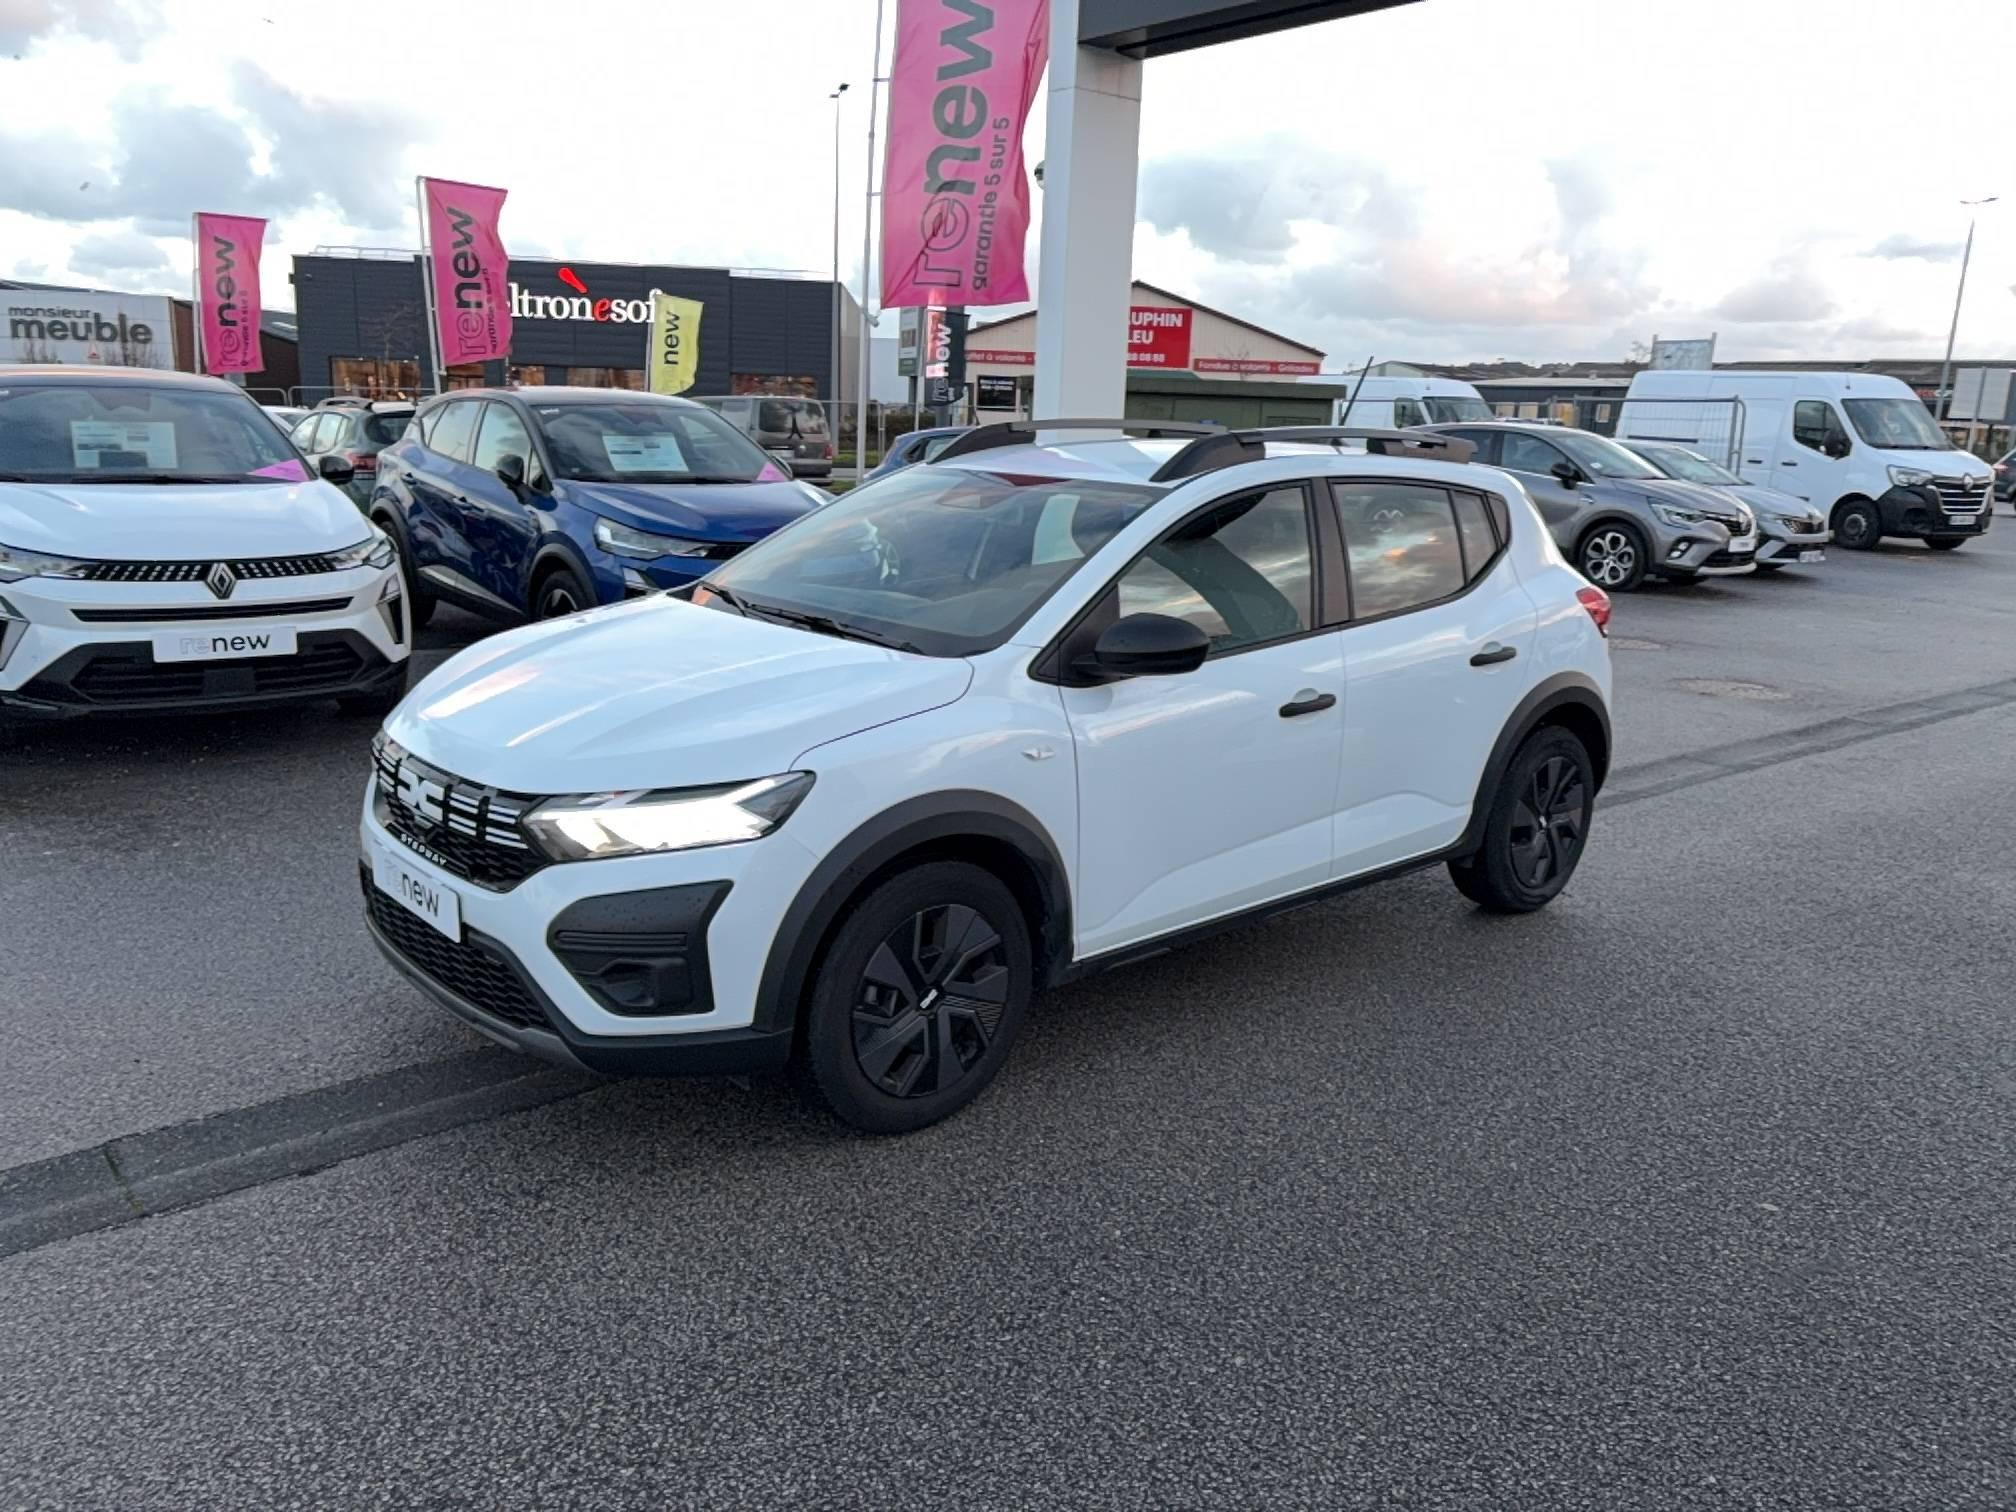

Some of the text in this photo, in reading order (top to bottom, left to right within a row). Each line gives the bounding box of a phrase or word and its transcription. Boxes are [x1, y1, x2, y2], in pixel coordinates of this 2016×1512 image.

[912, 0, 995, 288] renew
[972, 117, 1010, 291] garantie 5 sur 5
[8, 306, 91, 319] monsieur
[10, 312, 153, 344] meuble
[213, 235, 240, 367] renew
[446, 206, 488, 357] renew
[1128, 311, 1184, 327] UPHIN
